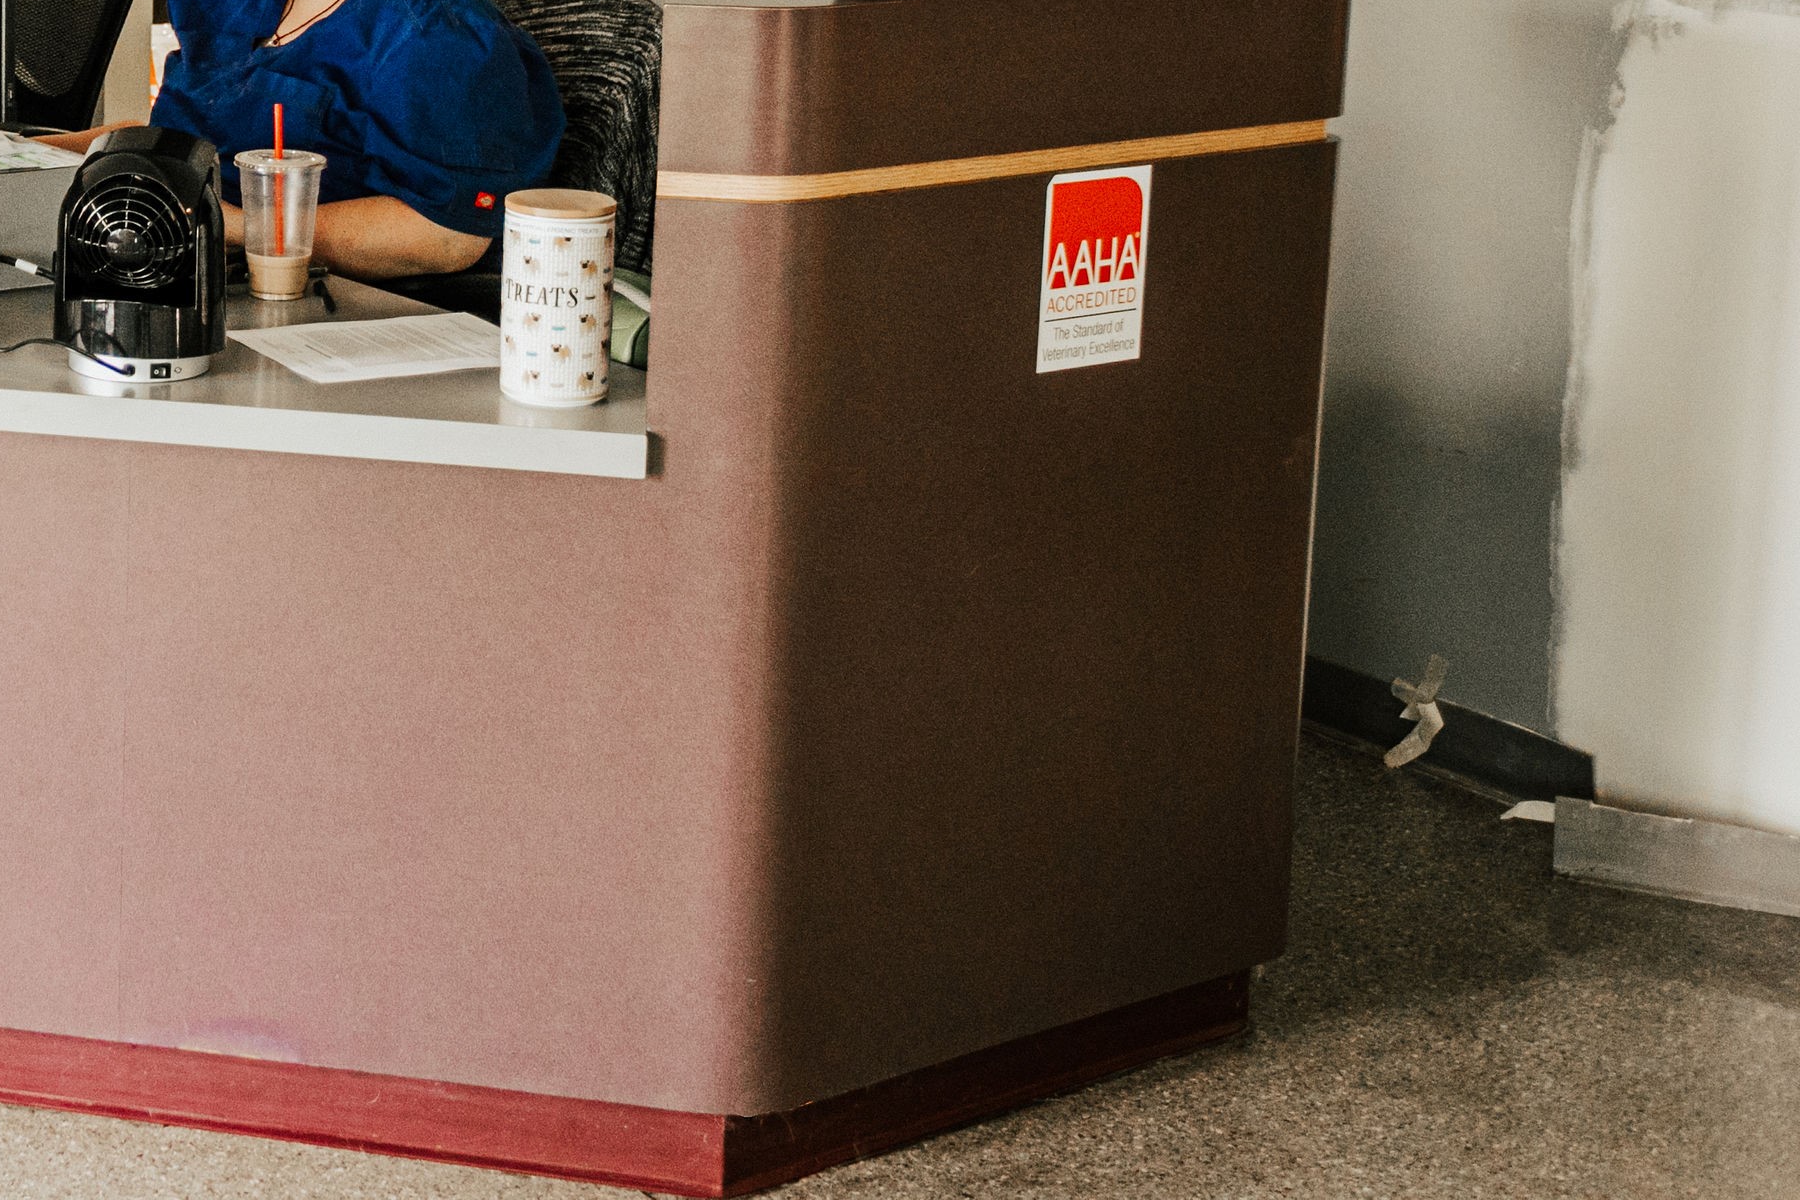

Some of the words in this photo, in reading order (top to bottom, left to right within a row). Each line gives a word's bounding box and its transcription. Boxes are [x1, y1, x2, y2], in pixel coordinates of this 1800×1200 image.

[1046, 234, 1139, 289] AAHA
[505, 278, 579, 309] TREATS
[1047, 287, 1137, 313] ACCREDITED
[1054, 327, 1070, 341] The
[1073, 321, 1112, 339] Standard
[1114, 319, 1125, 332] of
[1042, 345, 1087, 362] Veterinary
[1089, 339, 1135, 356] Excellence
